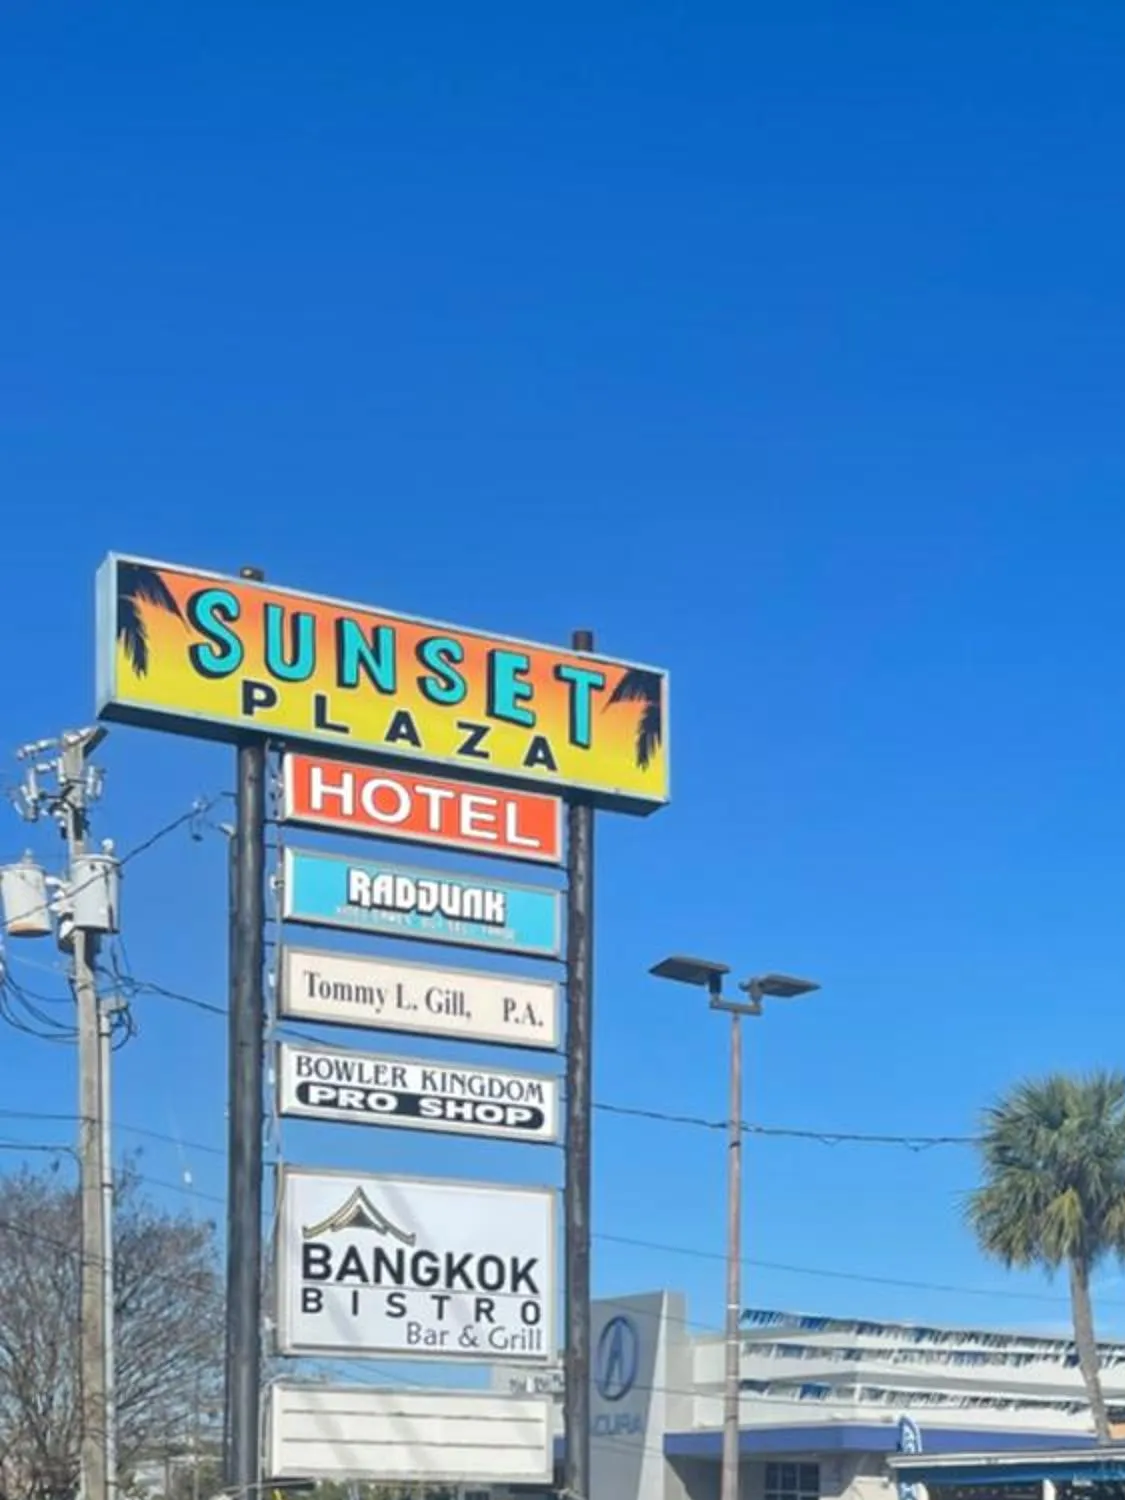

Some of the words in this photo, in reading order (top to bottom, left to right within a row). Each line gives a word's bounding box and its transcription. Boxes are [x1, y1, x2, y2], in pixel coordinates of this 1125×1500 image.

[188, 587, 605, 749] SUNSET
[241, 679, 557, 771] PLAZA
[308, 766, 541, 848] HOTEL
[347, 867, 506, 927] RADJUNK
[303, 969, 386, 1013] Tommy
[395, 984, 418, 1010] L.
[503, 996, 544, 1026] P.A.
[296, 1055, 409, 1089] BOWLER
[420, 1070, 545, 1103] KINGDOM
[308, 1085, 397, 1111] PRO
[419, 1098, 532, 1124] SHOP
[302, 1243, 539, 1294] BANGKOK
[302, 1287, 541, 1325] BISTRO
[406, 1322, 449, 1346] Bar
[458, 1324, 480, 1348] &
[488, 1326, 542, 1351] Grill
[591, 1413, 642, 1437] CURA
